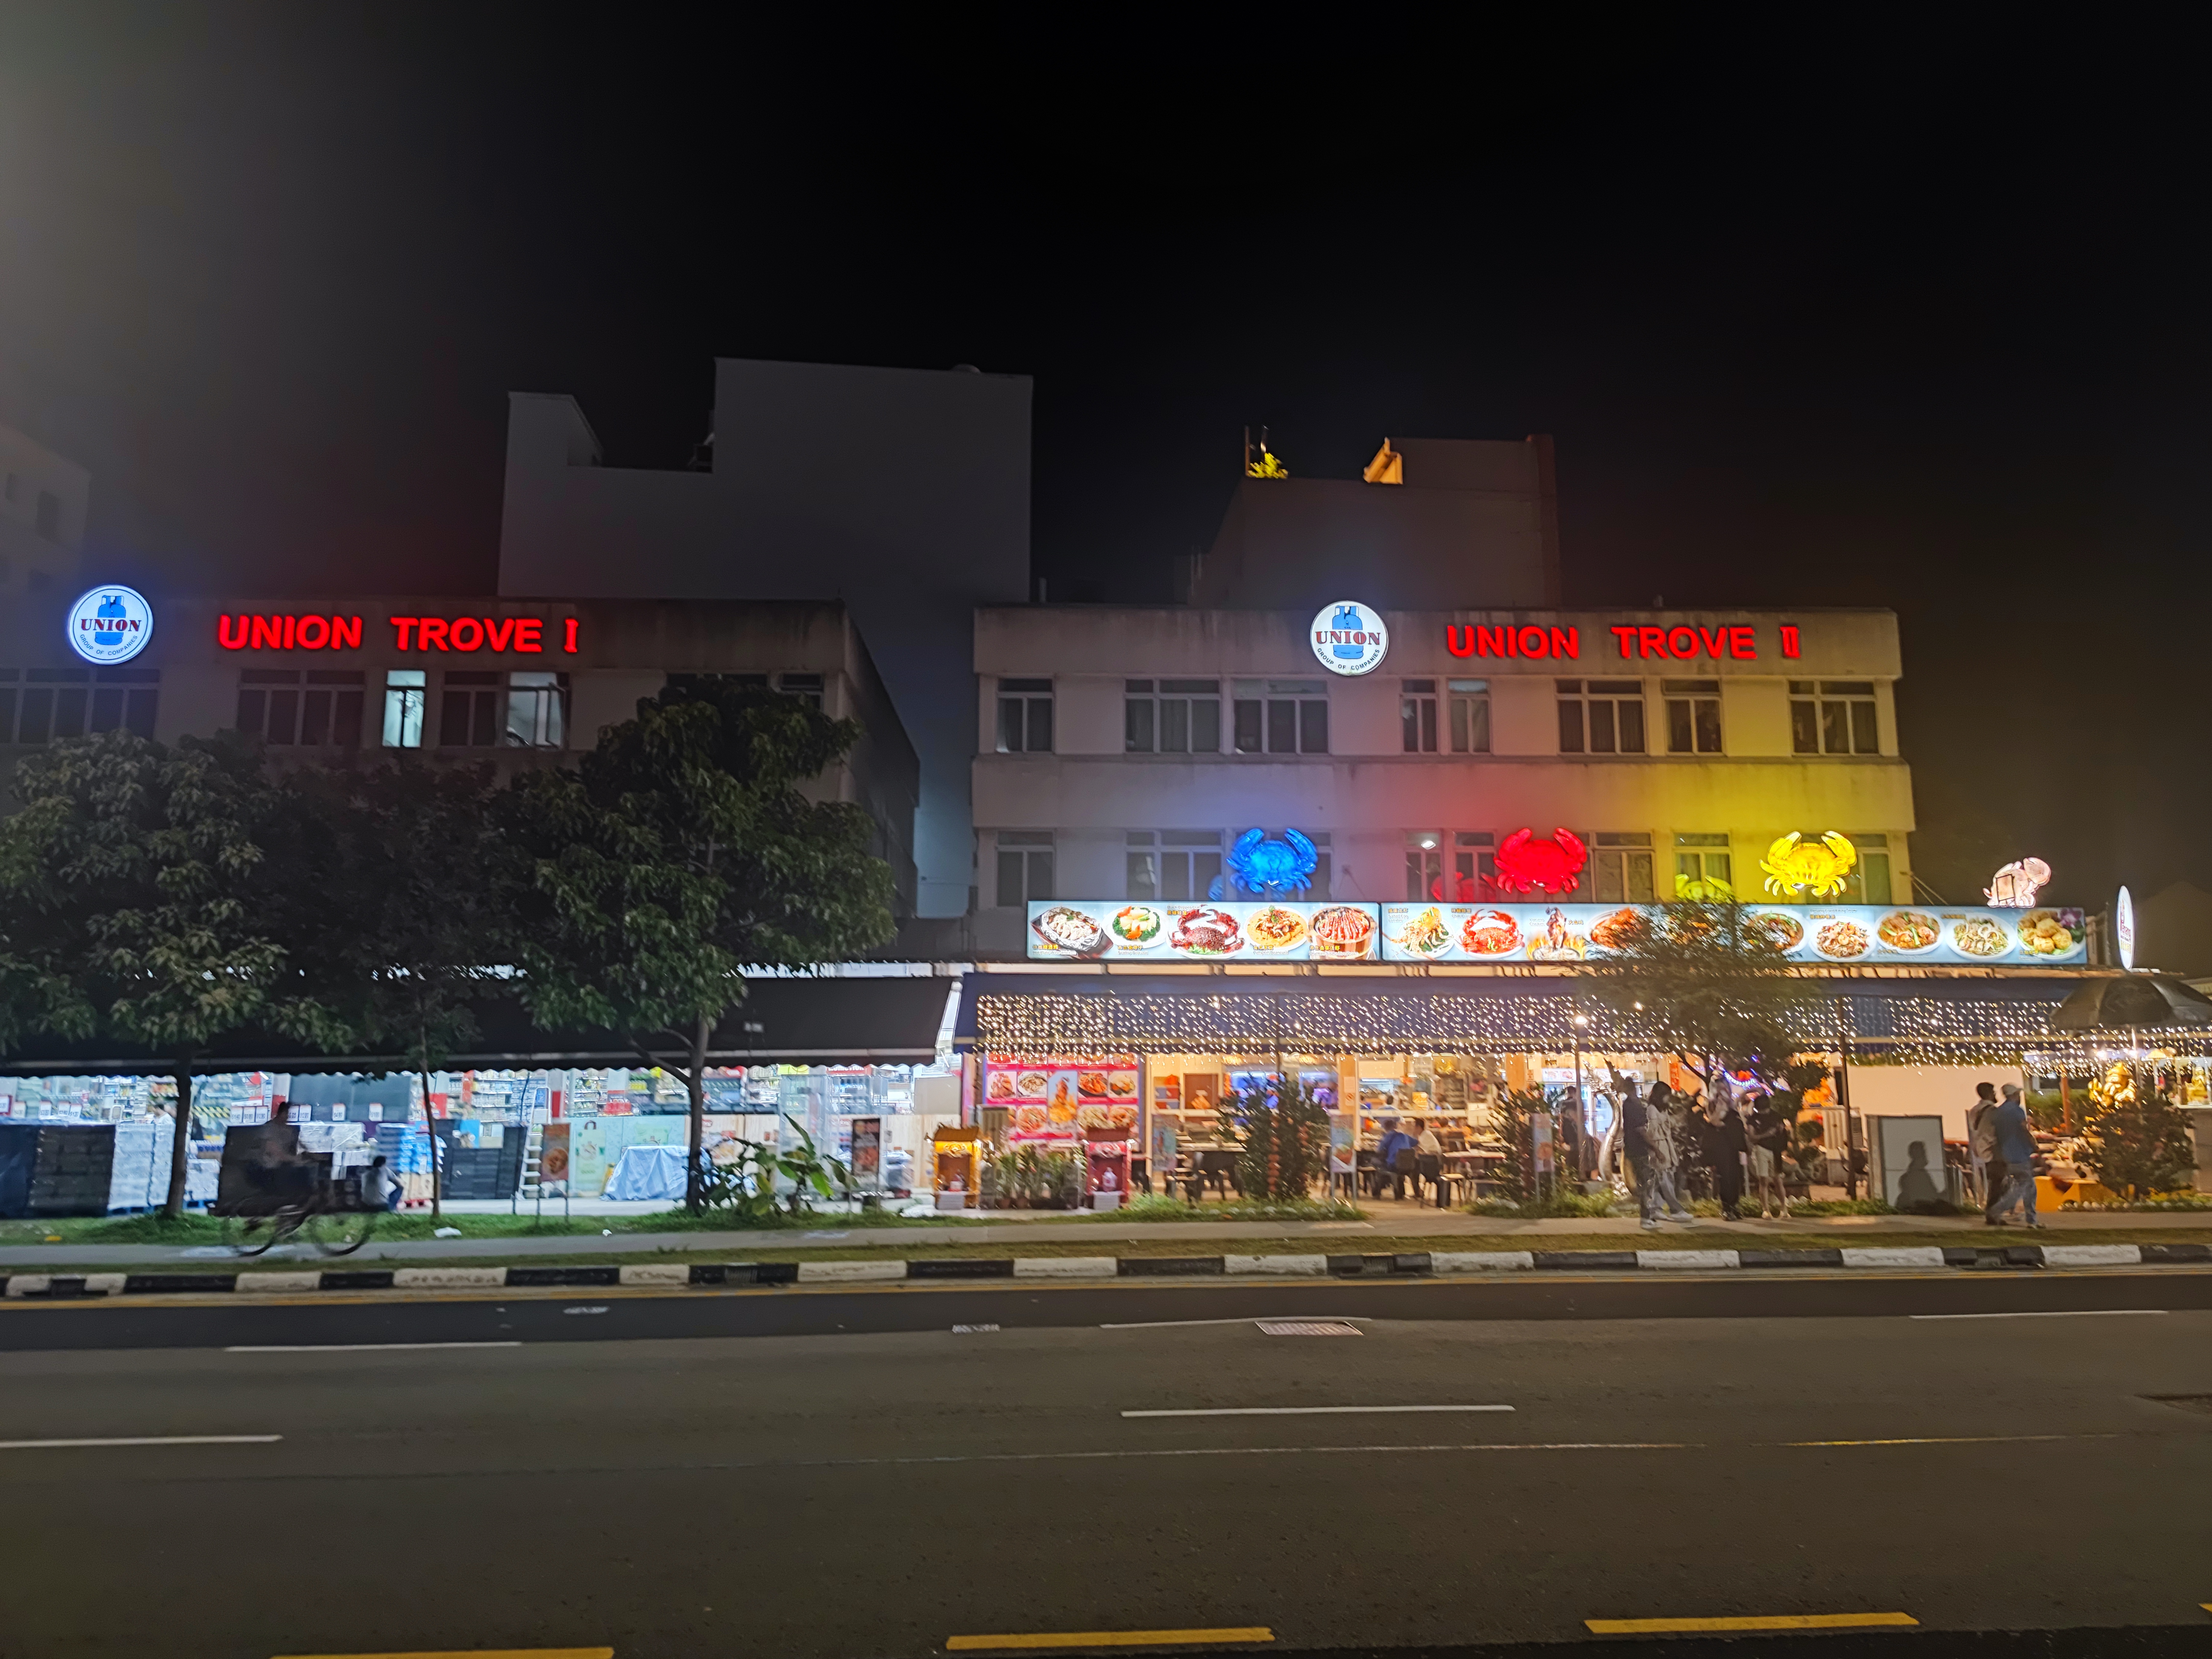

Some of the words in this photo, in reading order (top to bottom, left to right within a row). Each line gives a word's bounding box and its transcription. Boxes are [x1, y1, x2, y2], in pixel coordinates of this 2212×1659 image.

[81, 618, 142, 632] UNION
[219, 615, 362, 649] UNION
[390, 618, 542, 652] TROVE
[565, 619, 578, 652] I
[80, 634, 93, 650] GROUP
[108, 635, 138, 655] COMPANIES
[1315, 631, 1381, 645] UNION
[1448, 626, 1579, 659] UNION
[1611, 627, 1758, 659] TROVE
[1317, 648, 1334, 664] GROUP
[1351, 649, 1380, 670] COMPANIES
